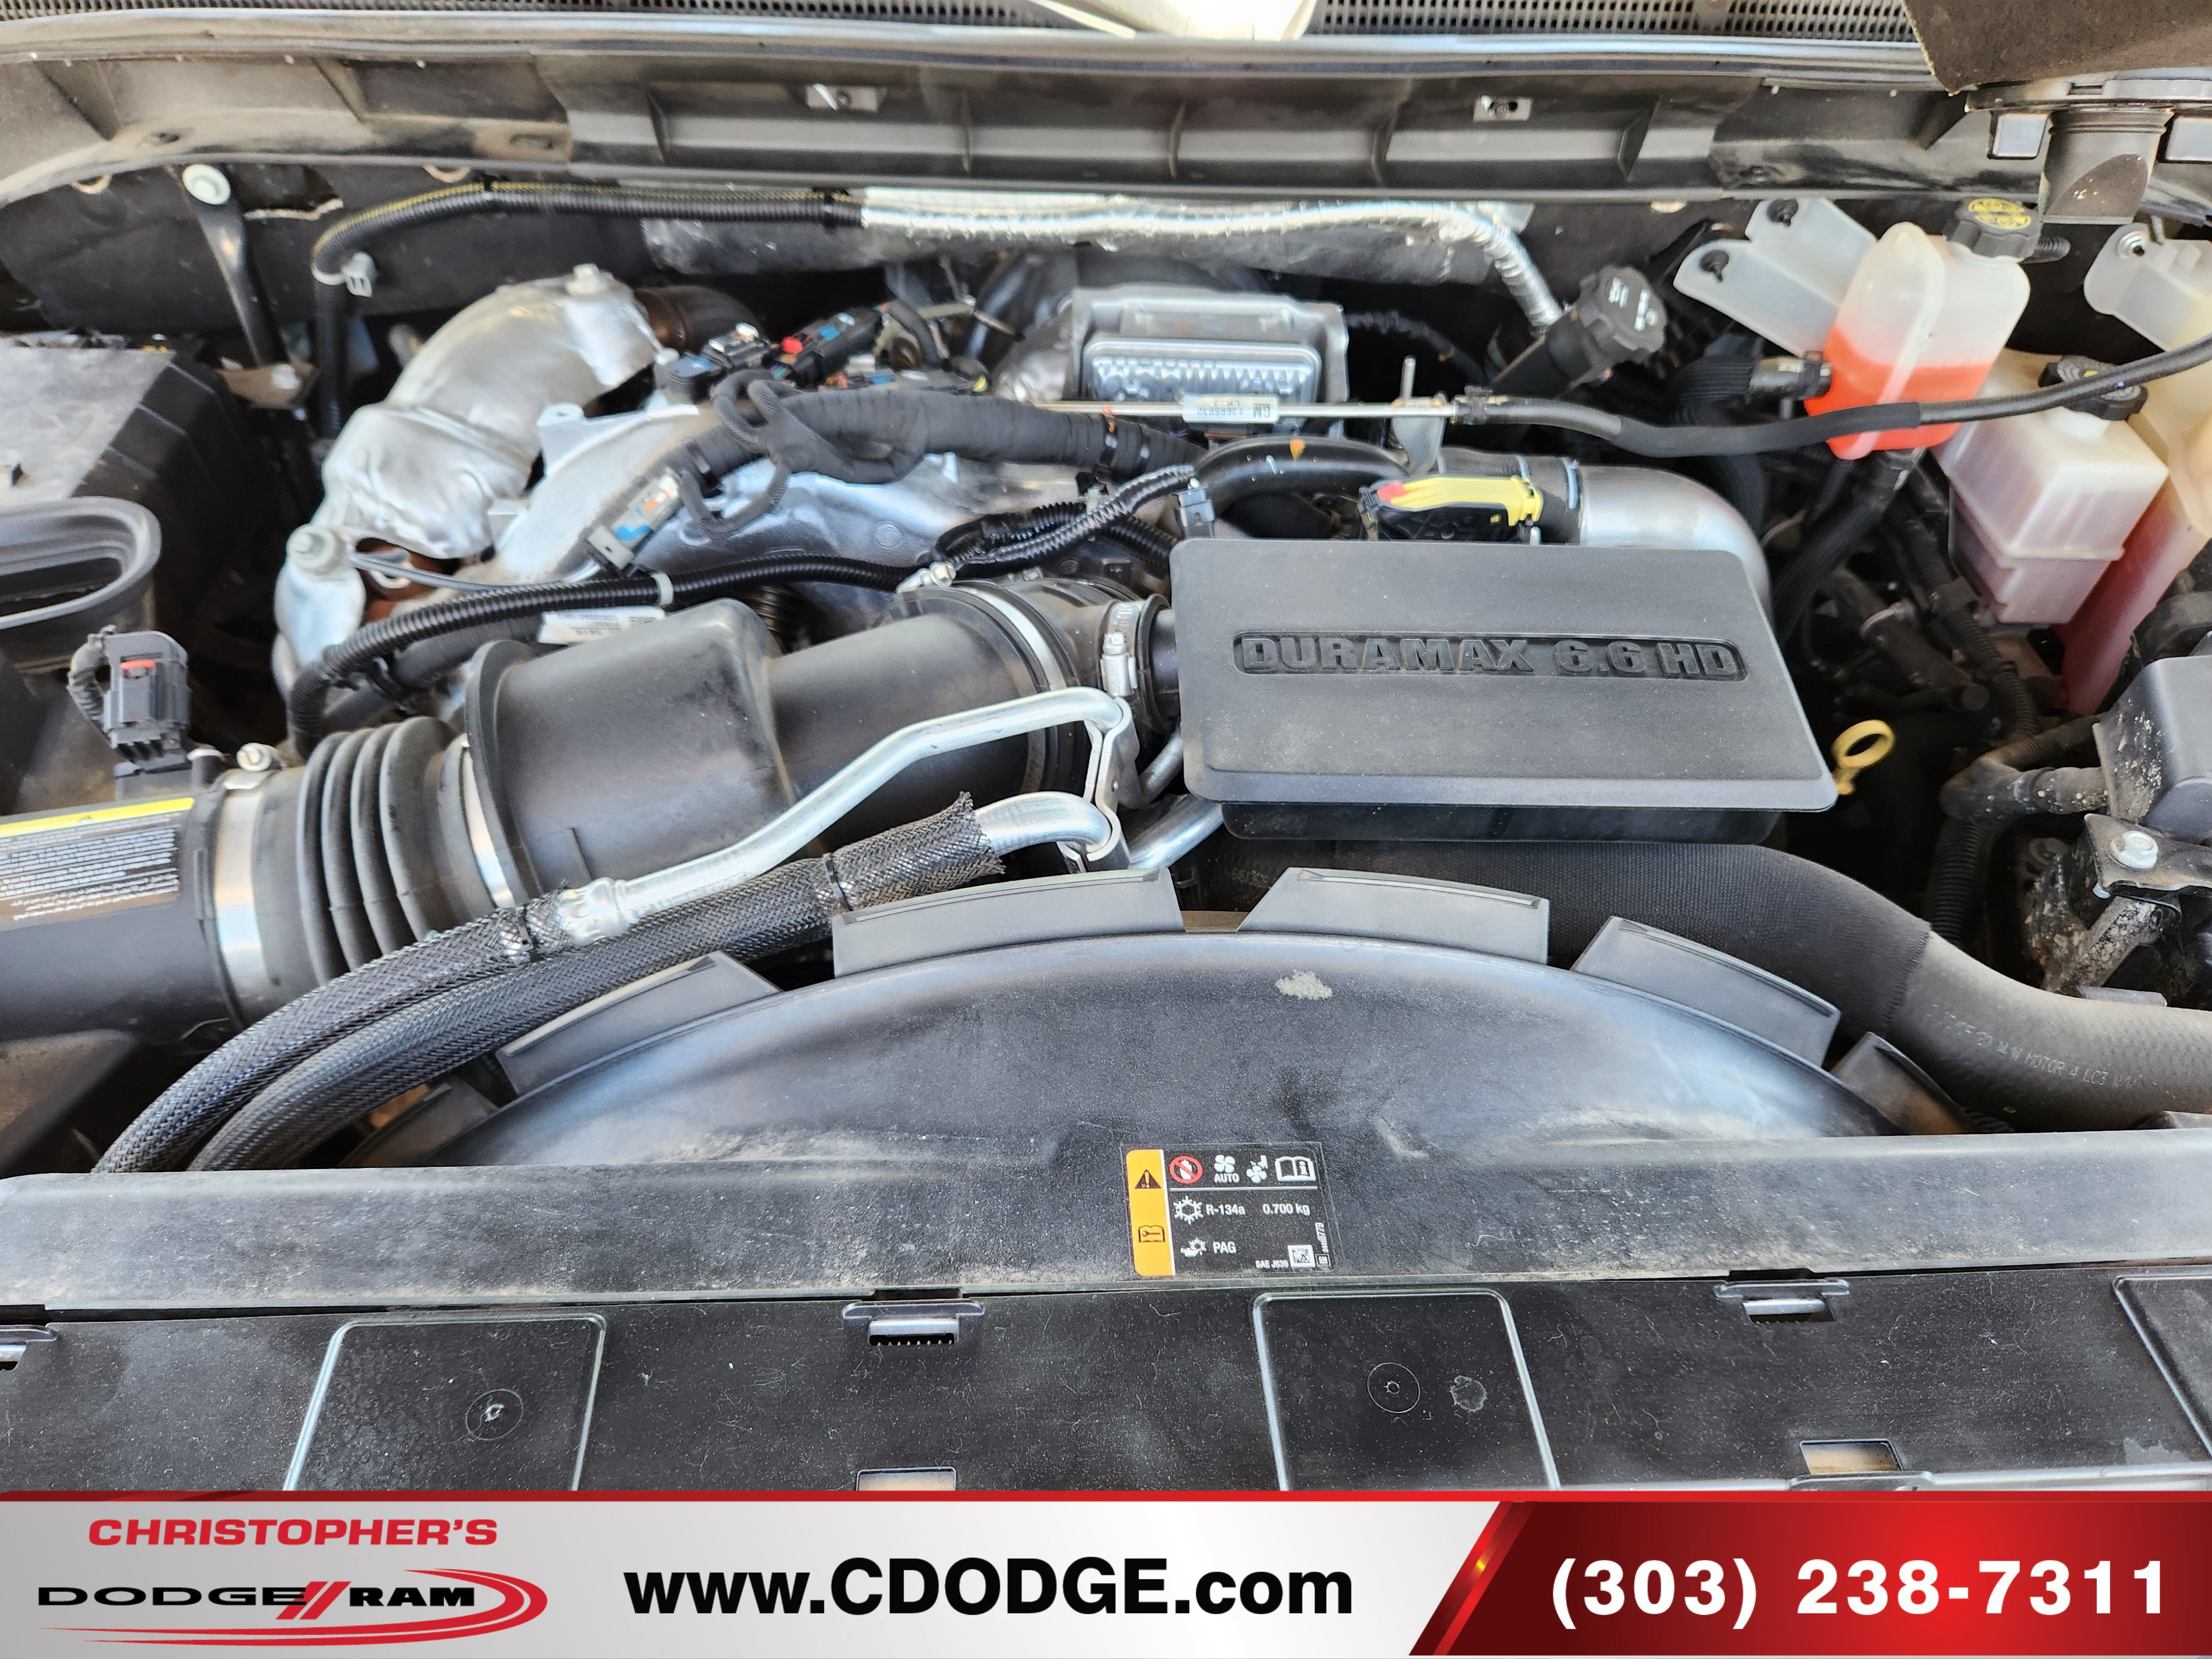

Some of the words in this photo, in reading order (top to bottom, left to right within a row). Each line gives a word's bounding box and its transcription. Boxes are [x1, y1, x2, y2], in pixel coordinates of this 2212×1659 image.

[1253, 406, 1271, 419] GM
[1241, 638, 1535, 672] DURAMAX
[1554, 640, 1648, 675] 6.6
[1660, 641, 1741, 676] HD
[1214, 1173, 1240, 1183] AUTO
[1206, 1204, 1246, 1216] R-134a
[1262, 1204, 1294, 1215] 0.700
[1296, 1203, 1311, 1216] kg
[1213, 1241, 1237, 1255] PAG
[1255, 1259, 1271, 1269] SAE
